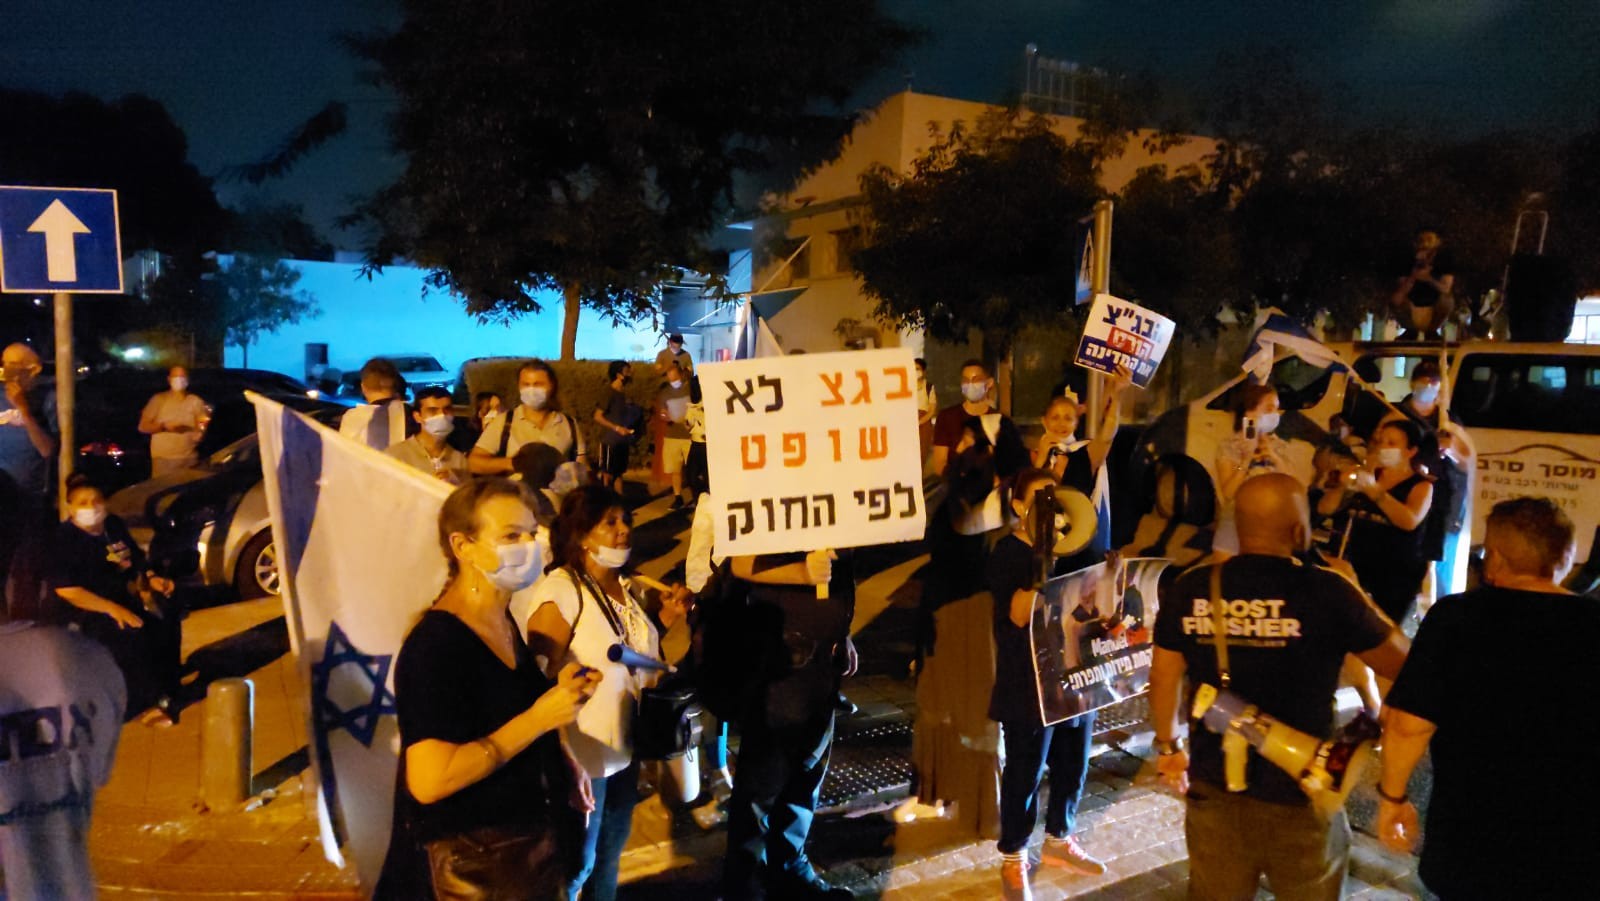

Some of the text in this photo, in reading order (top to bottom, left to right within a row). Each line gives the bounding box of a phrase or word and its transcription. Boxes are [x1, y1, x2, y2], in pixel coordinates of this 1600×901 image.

[1085, 342, 1139, 370] המדינה
[723, 366, 913, 415] בגצ לא
[740, 426, 889, 470] שופט
[1538, 463, 1597, 479] מוסך
[727, 481, 917, 541] לפי החוק
[1091, 632, 1129, 657] Manuel
